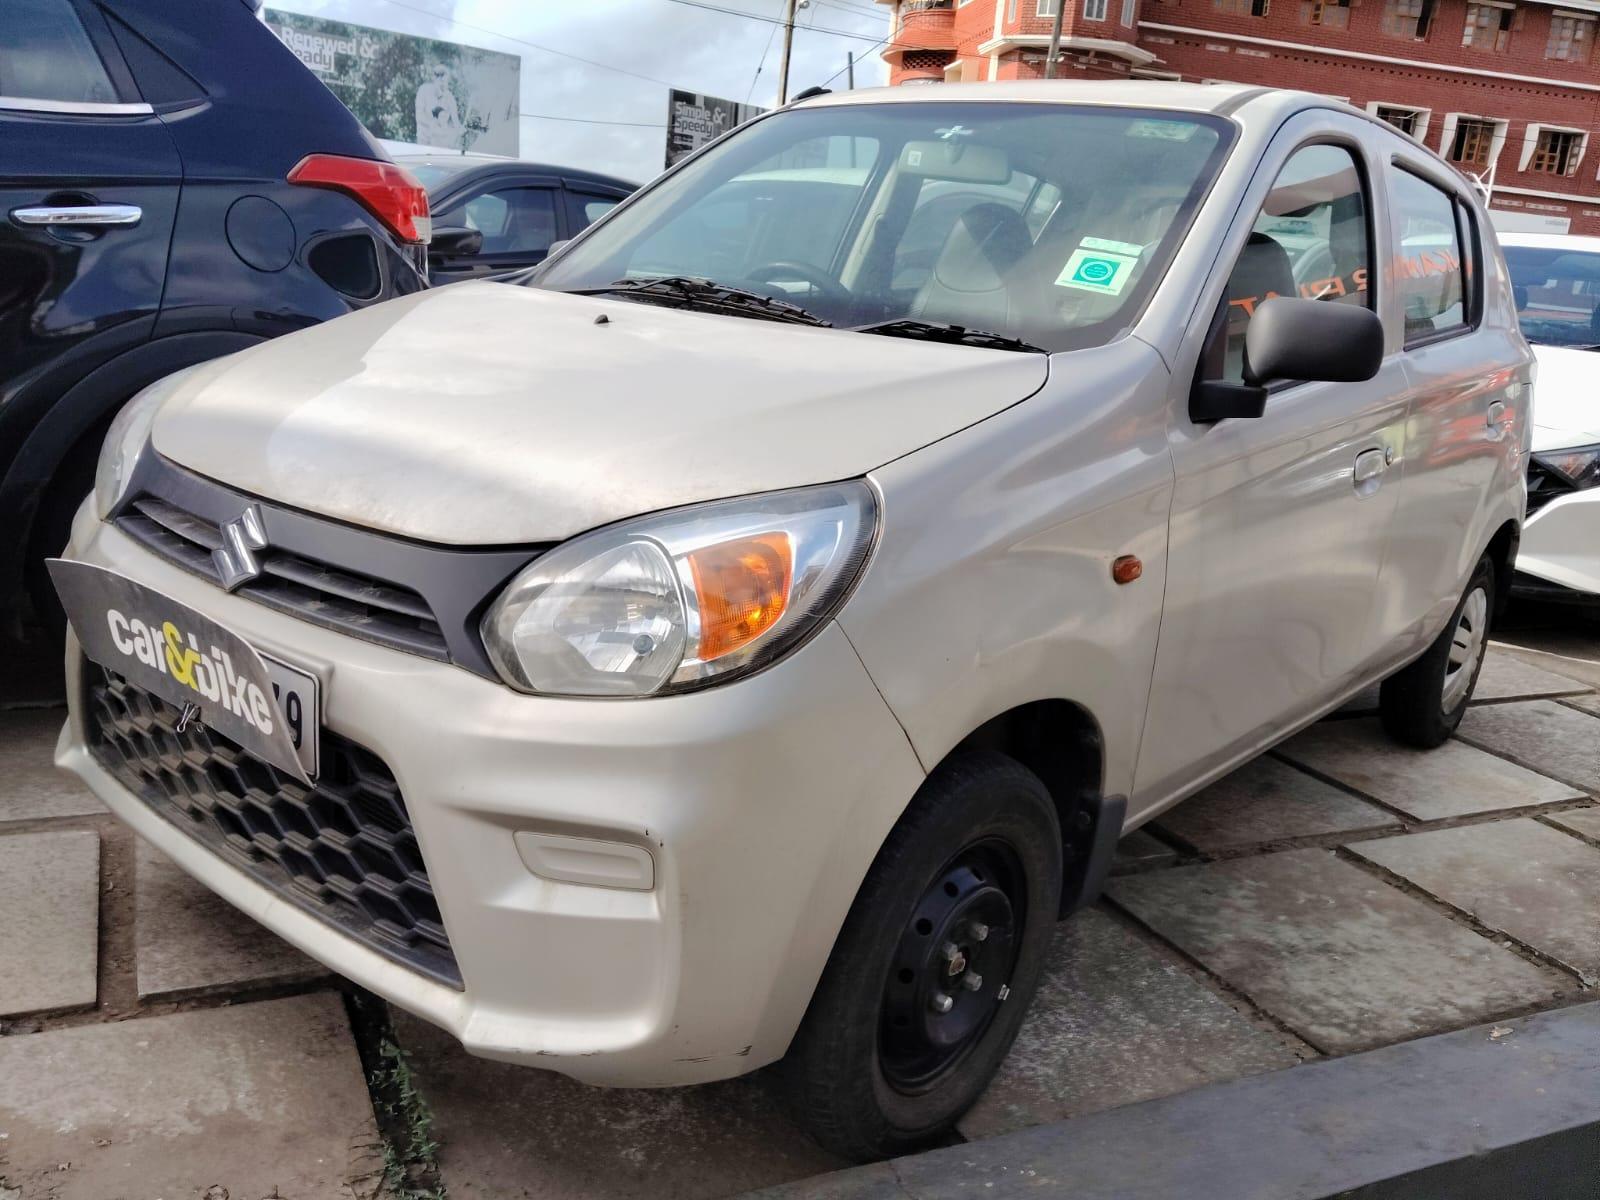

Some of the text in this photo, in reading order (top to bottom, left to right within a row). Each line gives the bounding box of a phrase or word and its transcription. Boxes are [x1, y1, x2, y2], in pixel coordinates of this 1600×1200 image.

[280, 26, 357, 56] Renewed
[293, 49, 333, 71] eady
[674, 101, 711, 121] Simple
[675, 117, 713, 138] Speedy
[106, 608, 274, 736] car&bike
